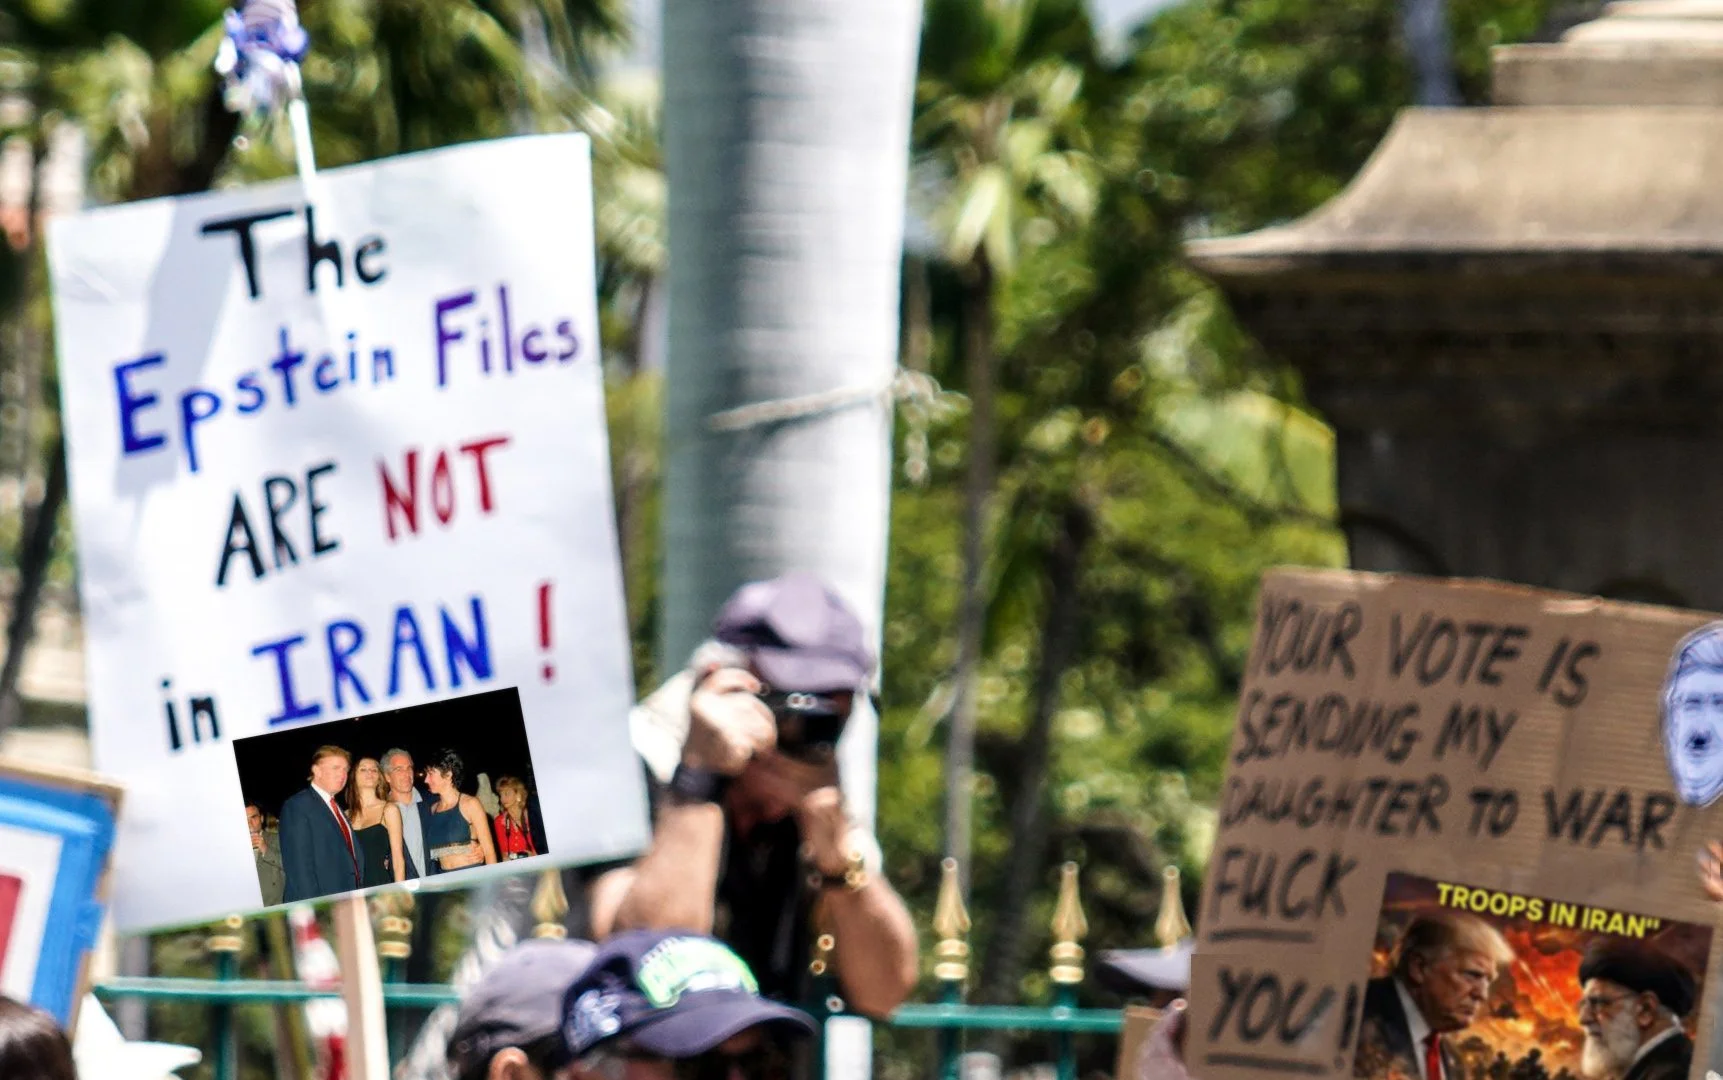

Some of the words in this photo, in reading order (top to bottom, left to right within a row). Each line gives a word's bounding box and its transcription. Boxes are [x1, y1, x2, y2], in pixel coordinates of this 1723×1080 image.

[199, 205, 389, 299] The
[112, 327, 397, 473] Epstein
[433, 284, 582, 390] Files
[216, 461, 343, 587] ARE
[378, 435, 514, 543] NOT
[158, 677, 223, 754] in
[251, 594, 496, 727] IRAN
[1259, 598, 1364, 681] YOUR
[1389, 611, 1531, 687] VOTE
[1535, 635, 1603, 709] IS
[1235, 688, 1424, 766] SENDING
[1432, 702, 1521, 772] MY
[1222, 773, 1452, 838] DAUGHTER
[1467, 789, 1520, 837] TO
[1543, 786, 1679, 853] WAR
[1210, 846, 1361, 923] FUCK
[1436, 883, 1544, 922] TROOPS
[1548, 903, 1577, 930] IN
